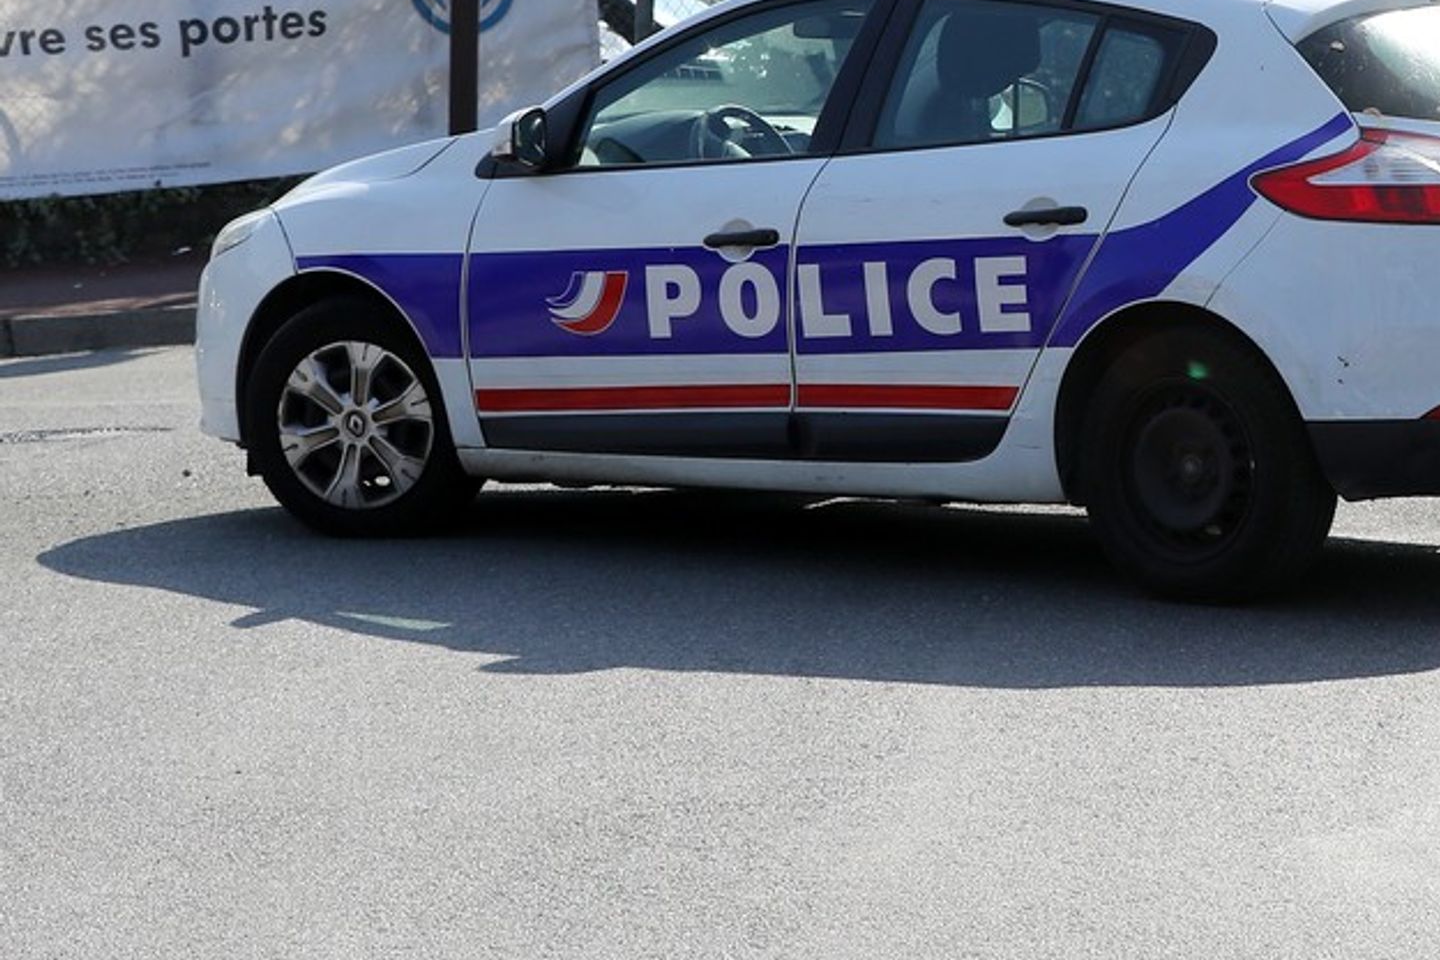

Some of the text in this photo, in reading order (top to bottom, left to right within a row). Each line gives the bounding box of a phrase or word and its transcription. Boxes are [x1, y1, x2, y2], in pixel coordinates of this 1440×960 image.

[84, 20, 161, 53] ses
[178, 6, 328, 58] portes
[644, 255, 1032, 339] POLICE
